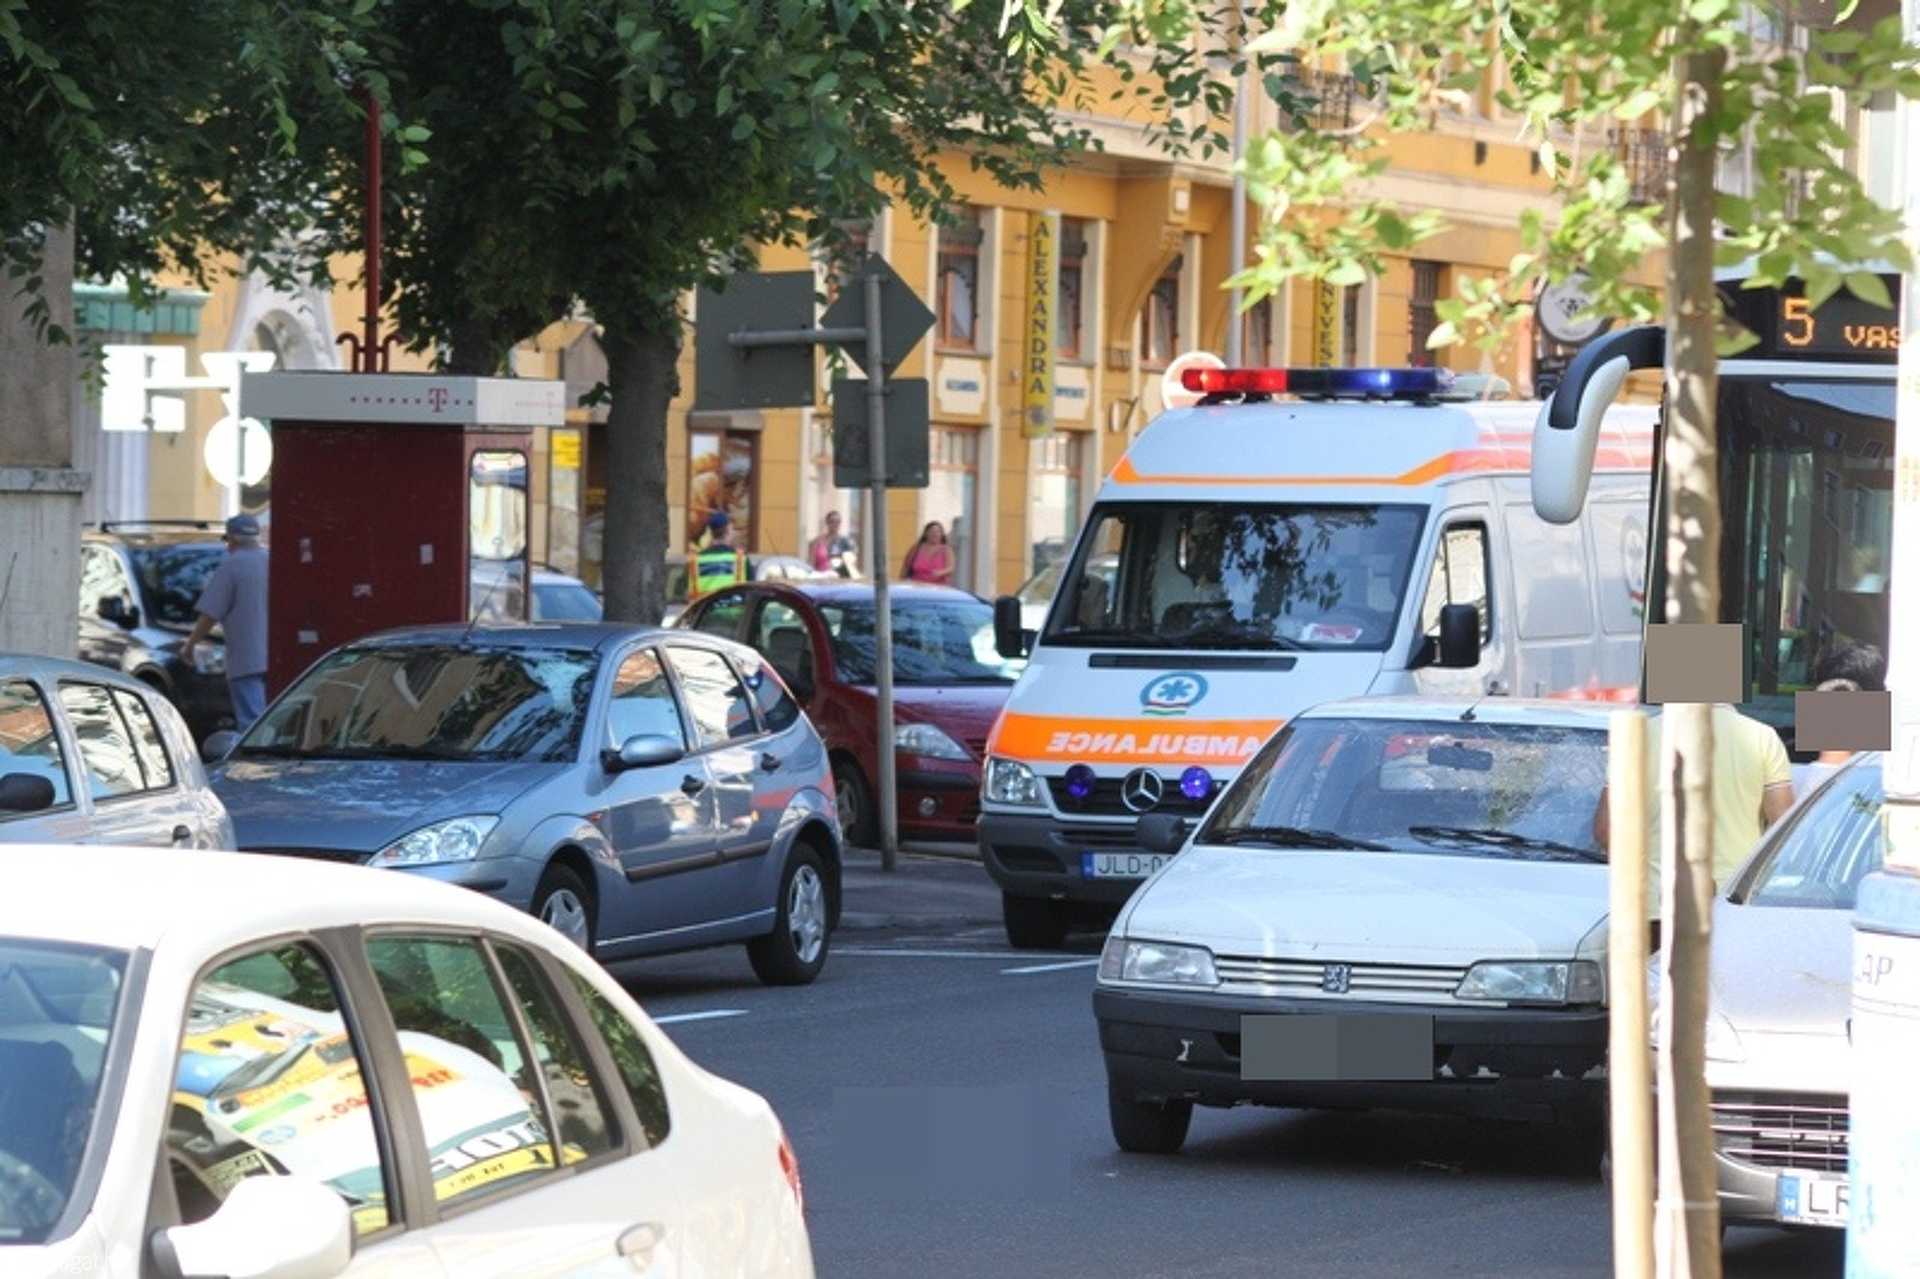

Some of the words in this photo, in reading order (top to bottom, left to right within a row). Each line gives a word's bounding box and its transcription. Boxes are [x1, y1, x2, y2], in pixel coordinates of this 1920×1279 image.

[1030, 221, 1049, 394] ALEXANDRA
[1784, 297, 1814, 346] 5
[1098, 856, 1172, 874] JLD-0
